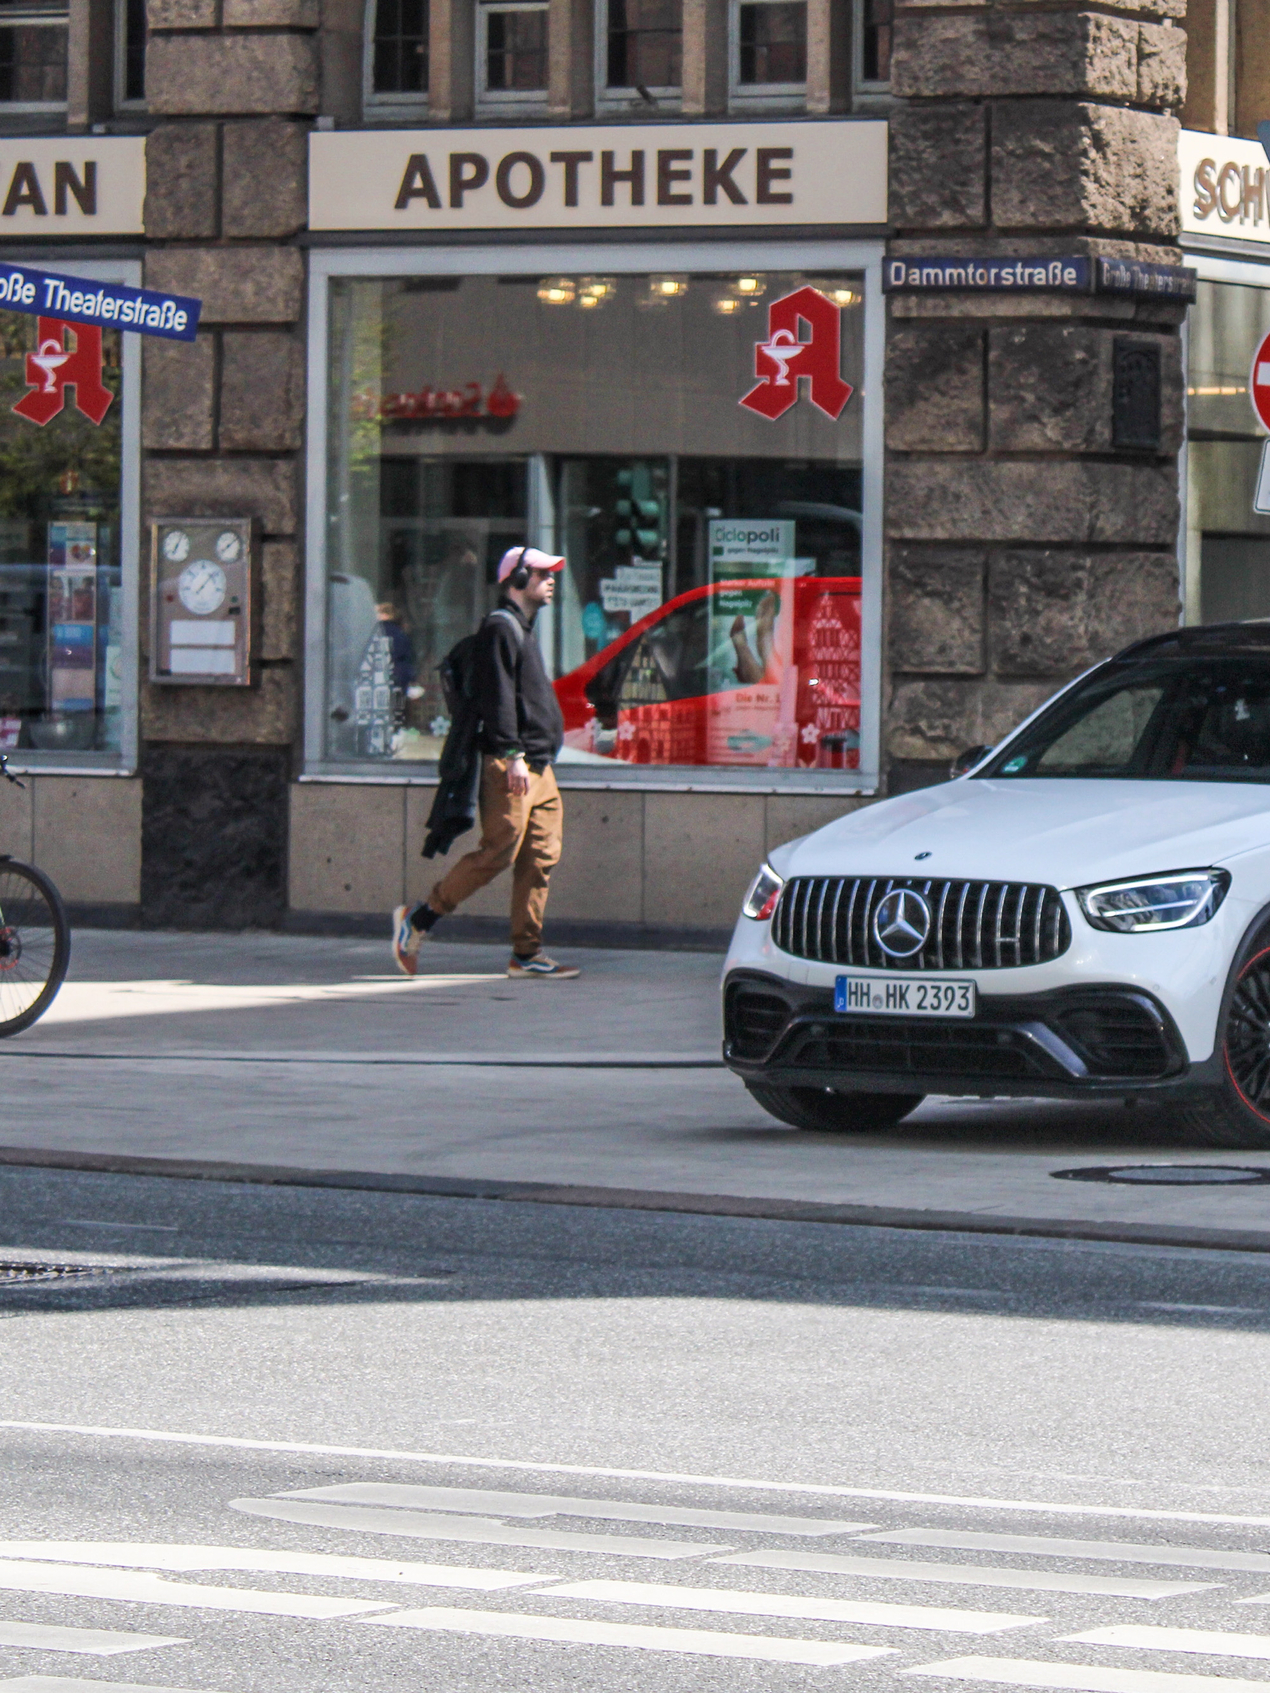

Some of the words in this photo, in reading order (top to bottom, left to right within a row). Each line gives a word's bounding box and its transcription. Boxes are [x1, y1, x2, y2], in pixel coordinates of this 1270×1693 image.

[394, 147, 794, 210] APOTHEKE
[890, 261, 1078, 286] Dammtorstraße
[43, 278, 188, 332] Theaterstraße
[715, 526, 780, 545] Ciclopoli
[848, 981, 871, 1008] HH
[886, 983, 910, 1010] HK
[916, 984, 972, 1012] 2393
